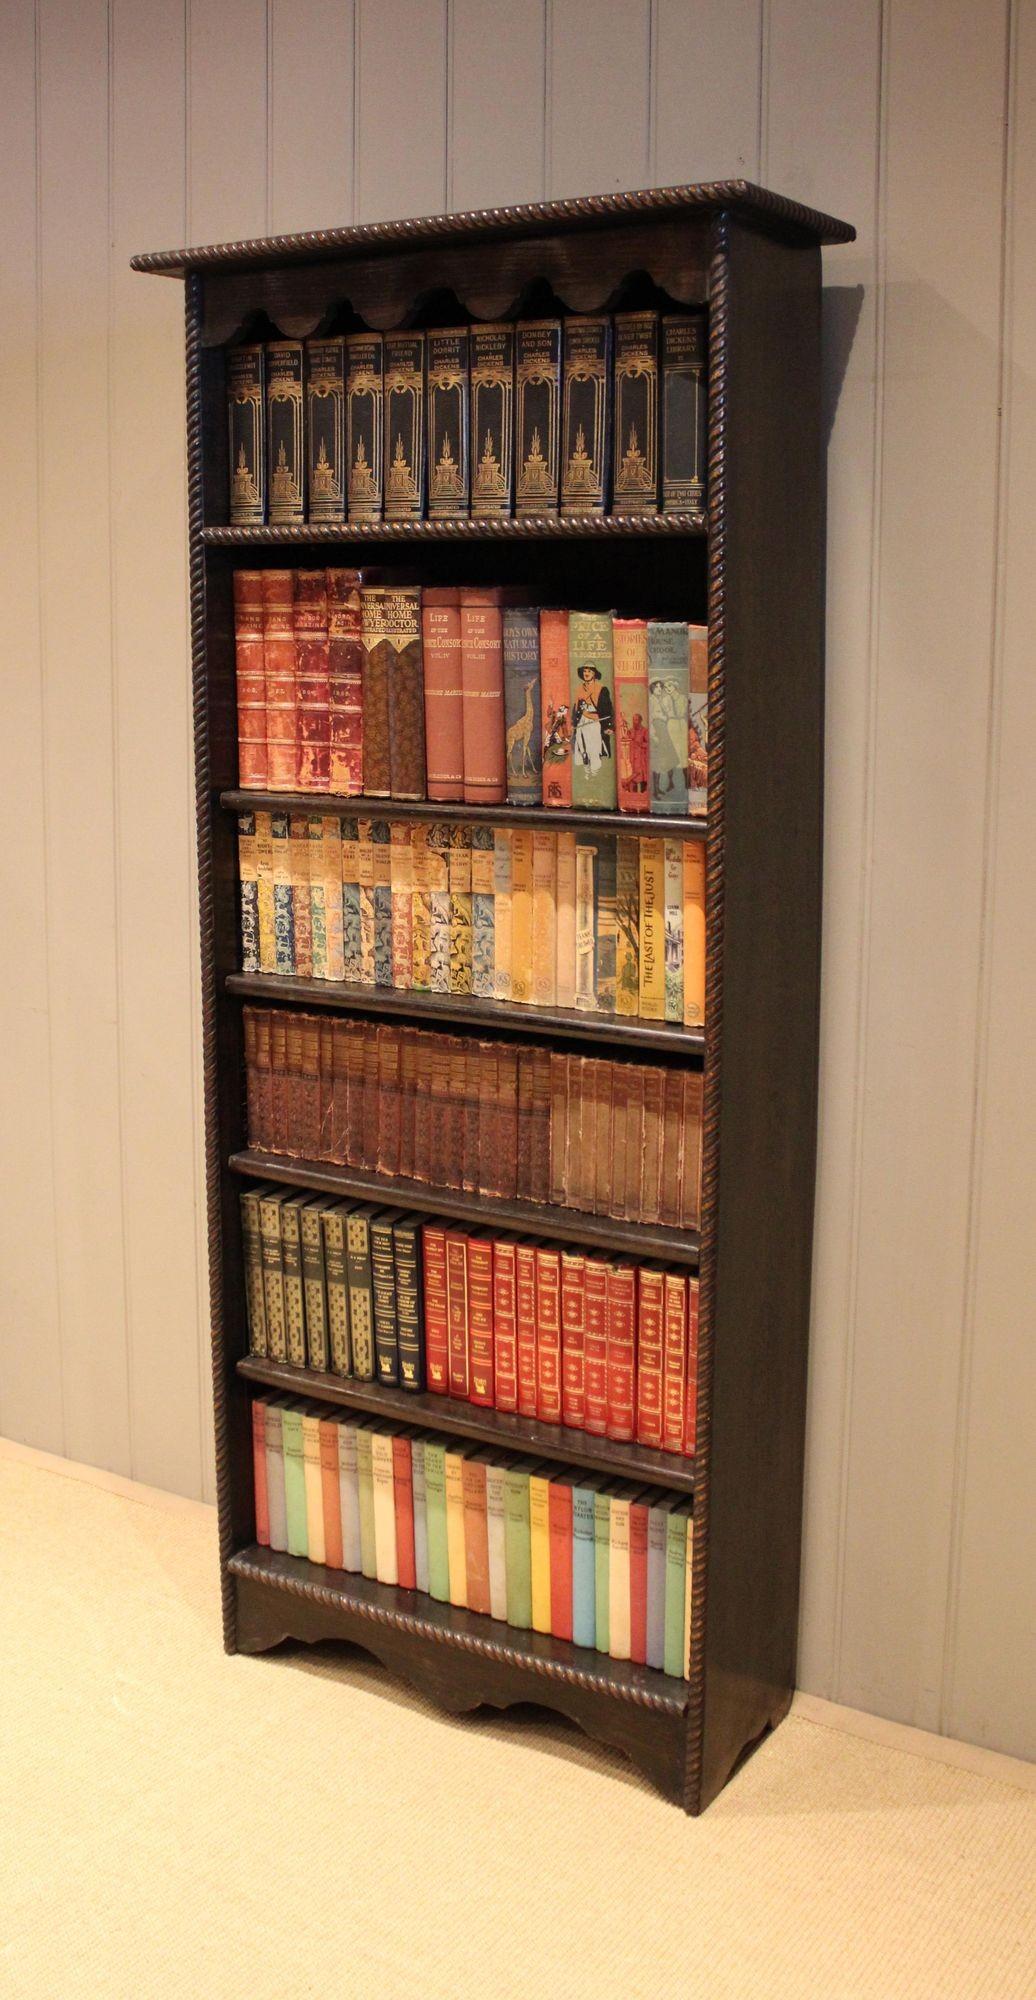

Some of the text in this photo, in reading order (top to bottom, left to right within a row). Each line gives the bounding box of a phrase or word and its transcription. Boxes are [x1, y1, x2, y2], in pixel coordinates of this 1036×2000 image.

[522, 331, 552, 339] DOMBEY
[666, 327, 696, 336] CHARLES
[434, 337, 460, 346] LITTLE
[476, 334, 506, 342] NICHOLAS
[666, 336, 697, 345] DICKENS
[475, 343, 506, 351] NICKLEBY
[666, 344, 697, 353] LIBRARY
[387, 611, 413, 619] HOME
[430, 613, 449, 622] LIFE
[467, 614, 487, 623] LIFE
[474, 637, 502, 649] CONSORT
[504, 639, 536, 649] NATURAL
[504, 651, 537, 661] HISTORY
[644, 865, 656, 899] JUST
[644, 898, 654, 922] THE
[644, 923, 653, 940] OF
[644, 940, 656, 965] LAST
[644, 965, 653, 987] THE
